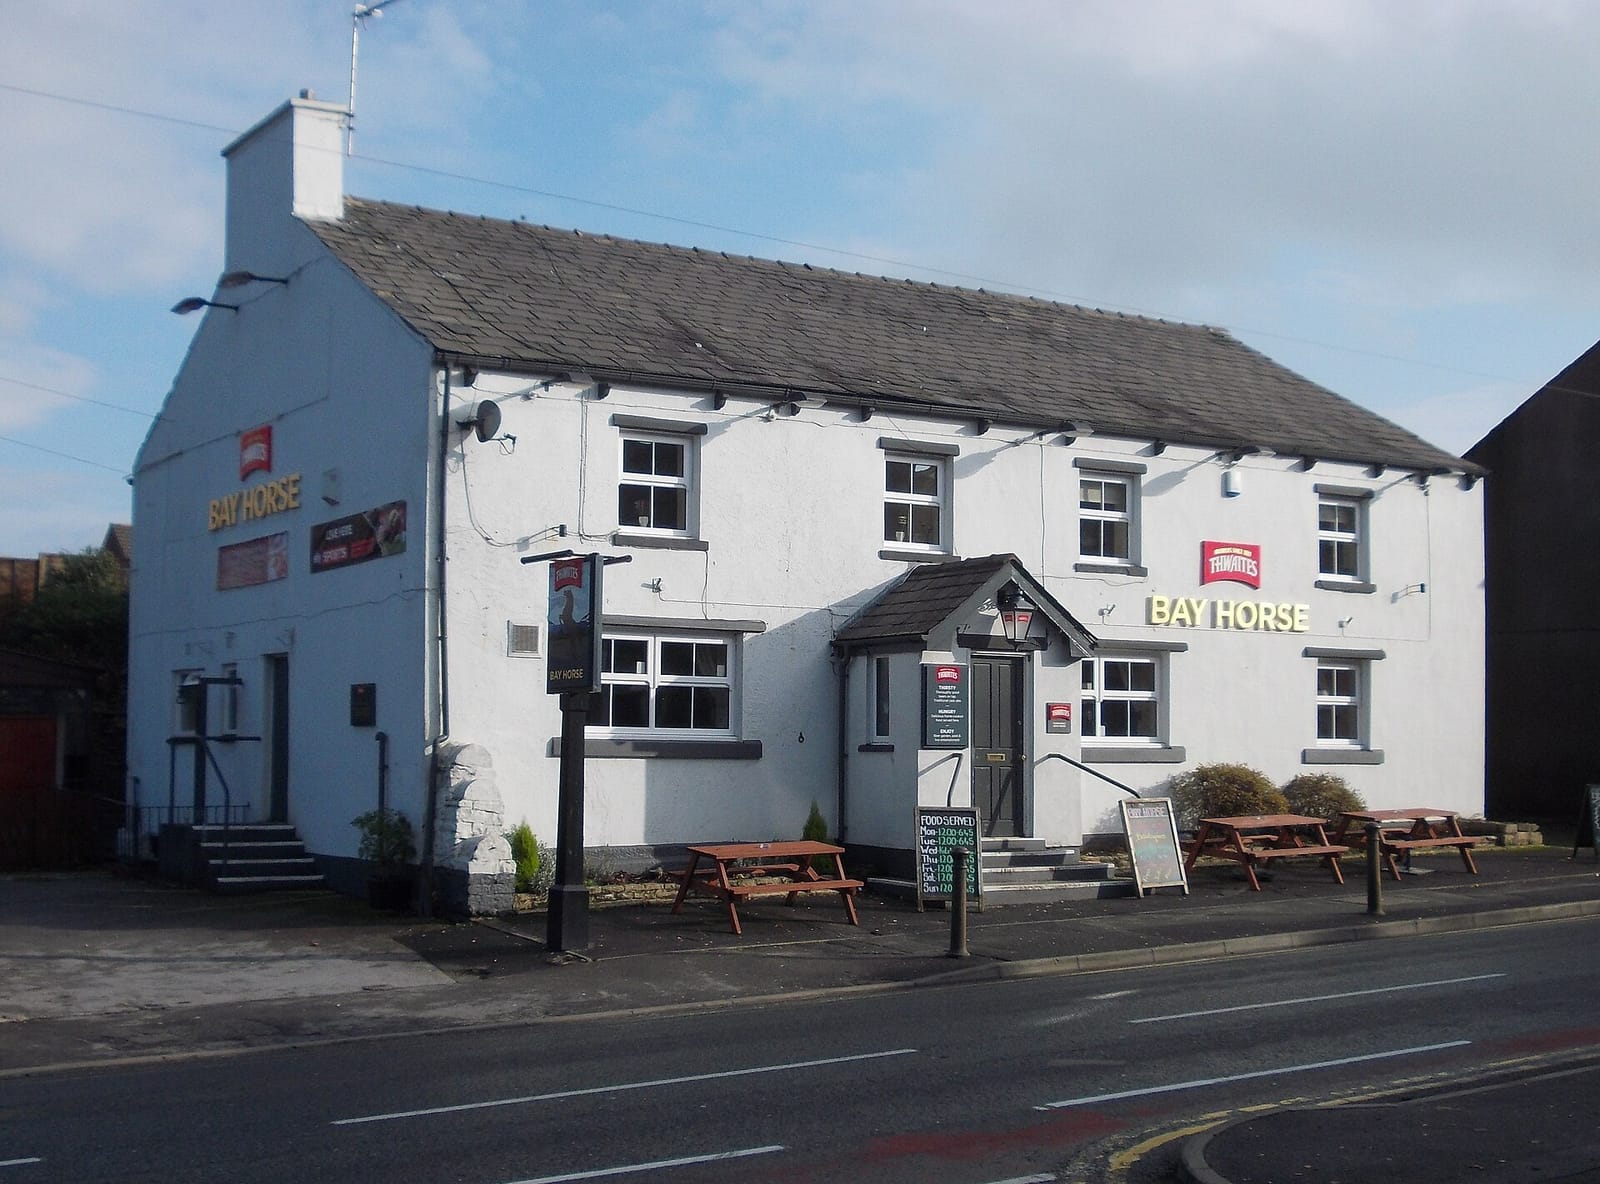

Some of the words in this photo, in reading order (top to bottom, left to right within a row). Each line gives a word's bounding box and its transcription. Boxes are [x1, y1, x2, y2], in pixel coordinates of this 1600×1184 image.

[208, 494, 238, 531] BAY
[242, 474, 300, 520] HORSE
[1208, 554, 1258, 577] THWAITES
[1149, 595, 1208, 625] BAY
[1212, 599, 1310, 632] HORSE
[550, 670, 562, 681] BAY
[562, 668, 584, 680] HORSE
[920, 815, 943, 826] FOOD
[943, 815, 976, 827] SERVED
